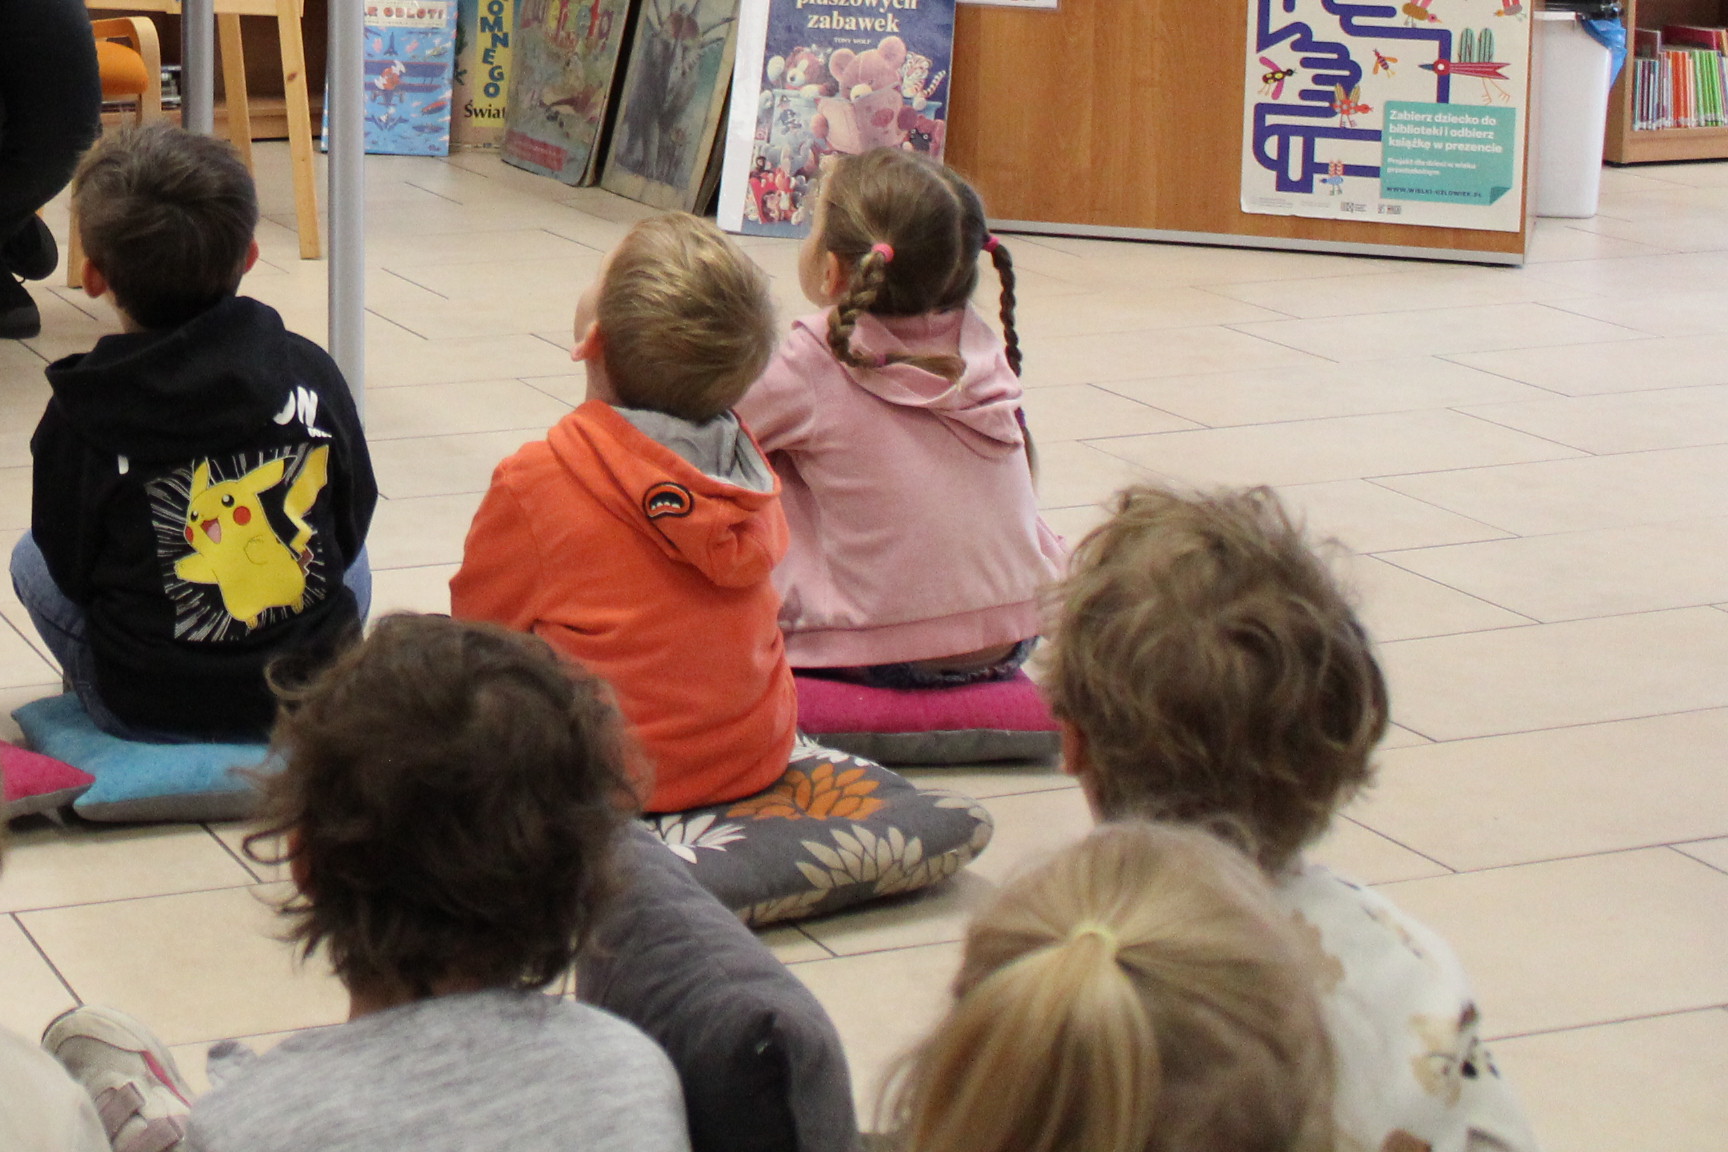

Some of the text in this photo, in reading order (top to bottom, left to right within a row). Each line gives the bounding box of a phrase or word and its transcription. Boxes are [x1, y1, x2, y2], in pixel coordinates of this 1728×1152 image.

[807, 11, 900, 33] zabawek
[1390, 110, 1496, 126] Zabierz dziecko do
[1389, 123, 1443, 136] biblioteki
[1450, 127, 1494, 139] odbierz
[1388, 137, 1503, 153] książkę w prezencie
